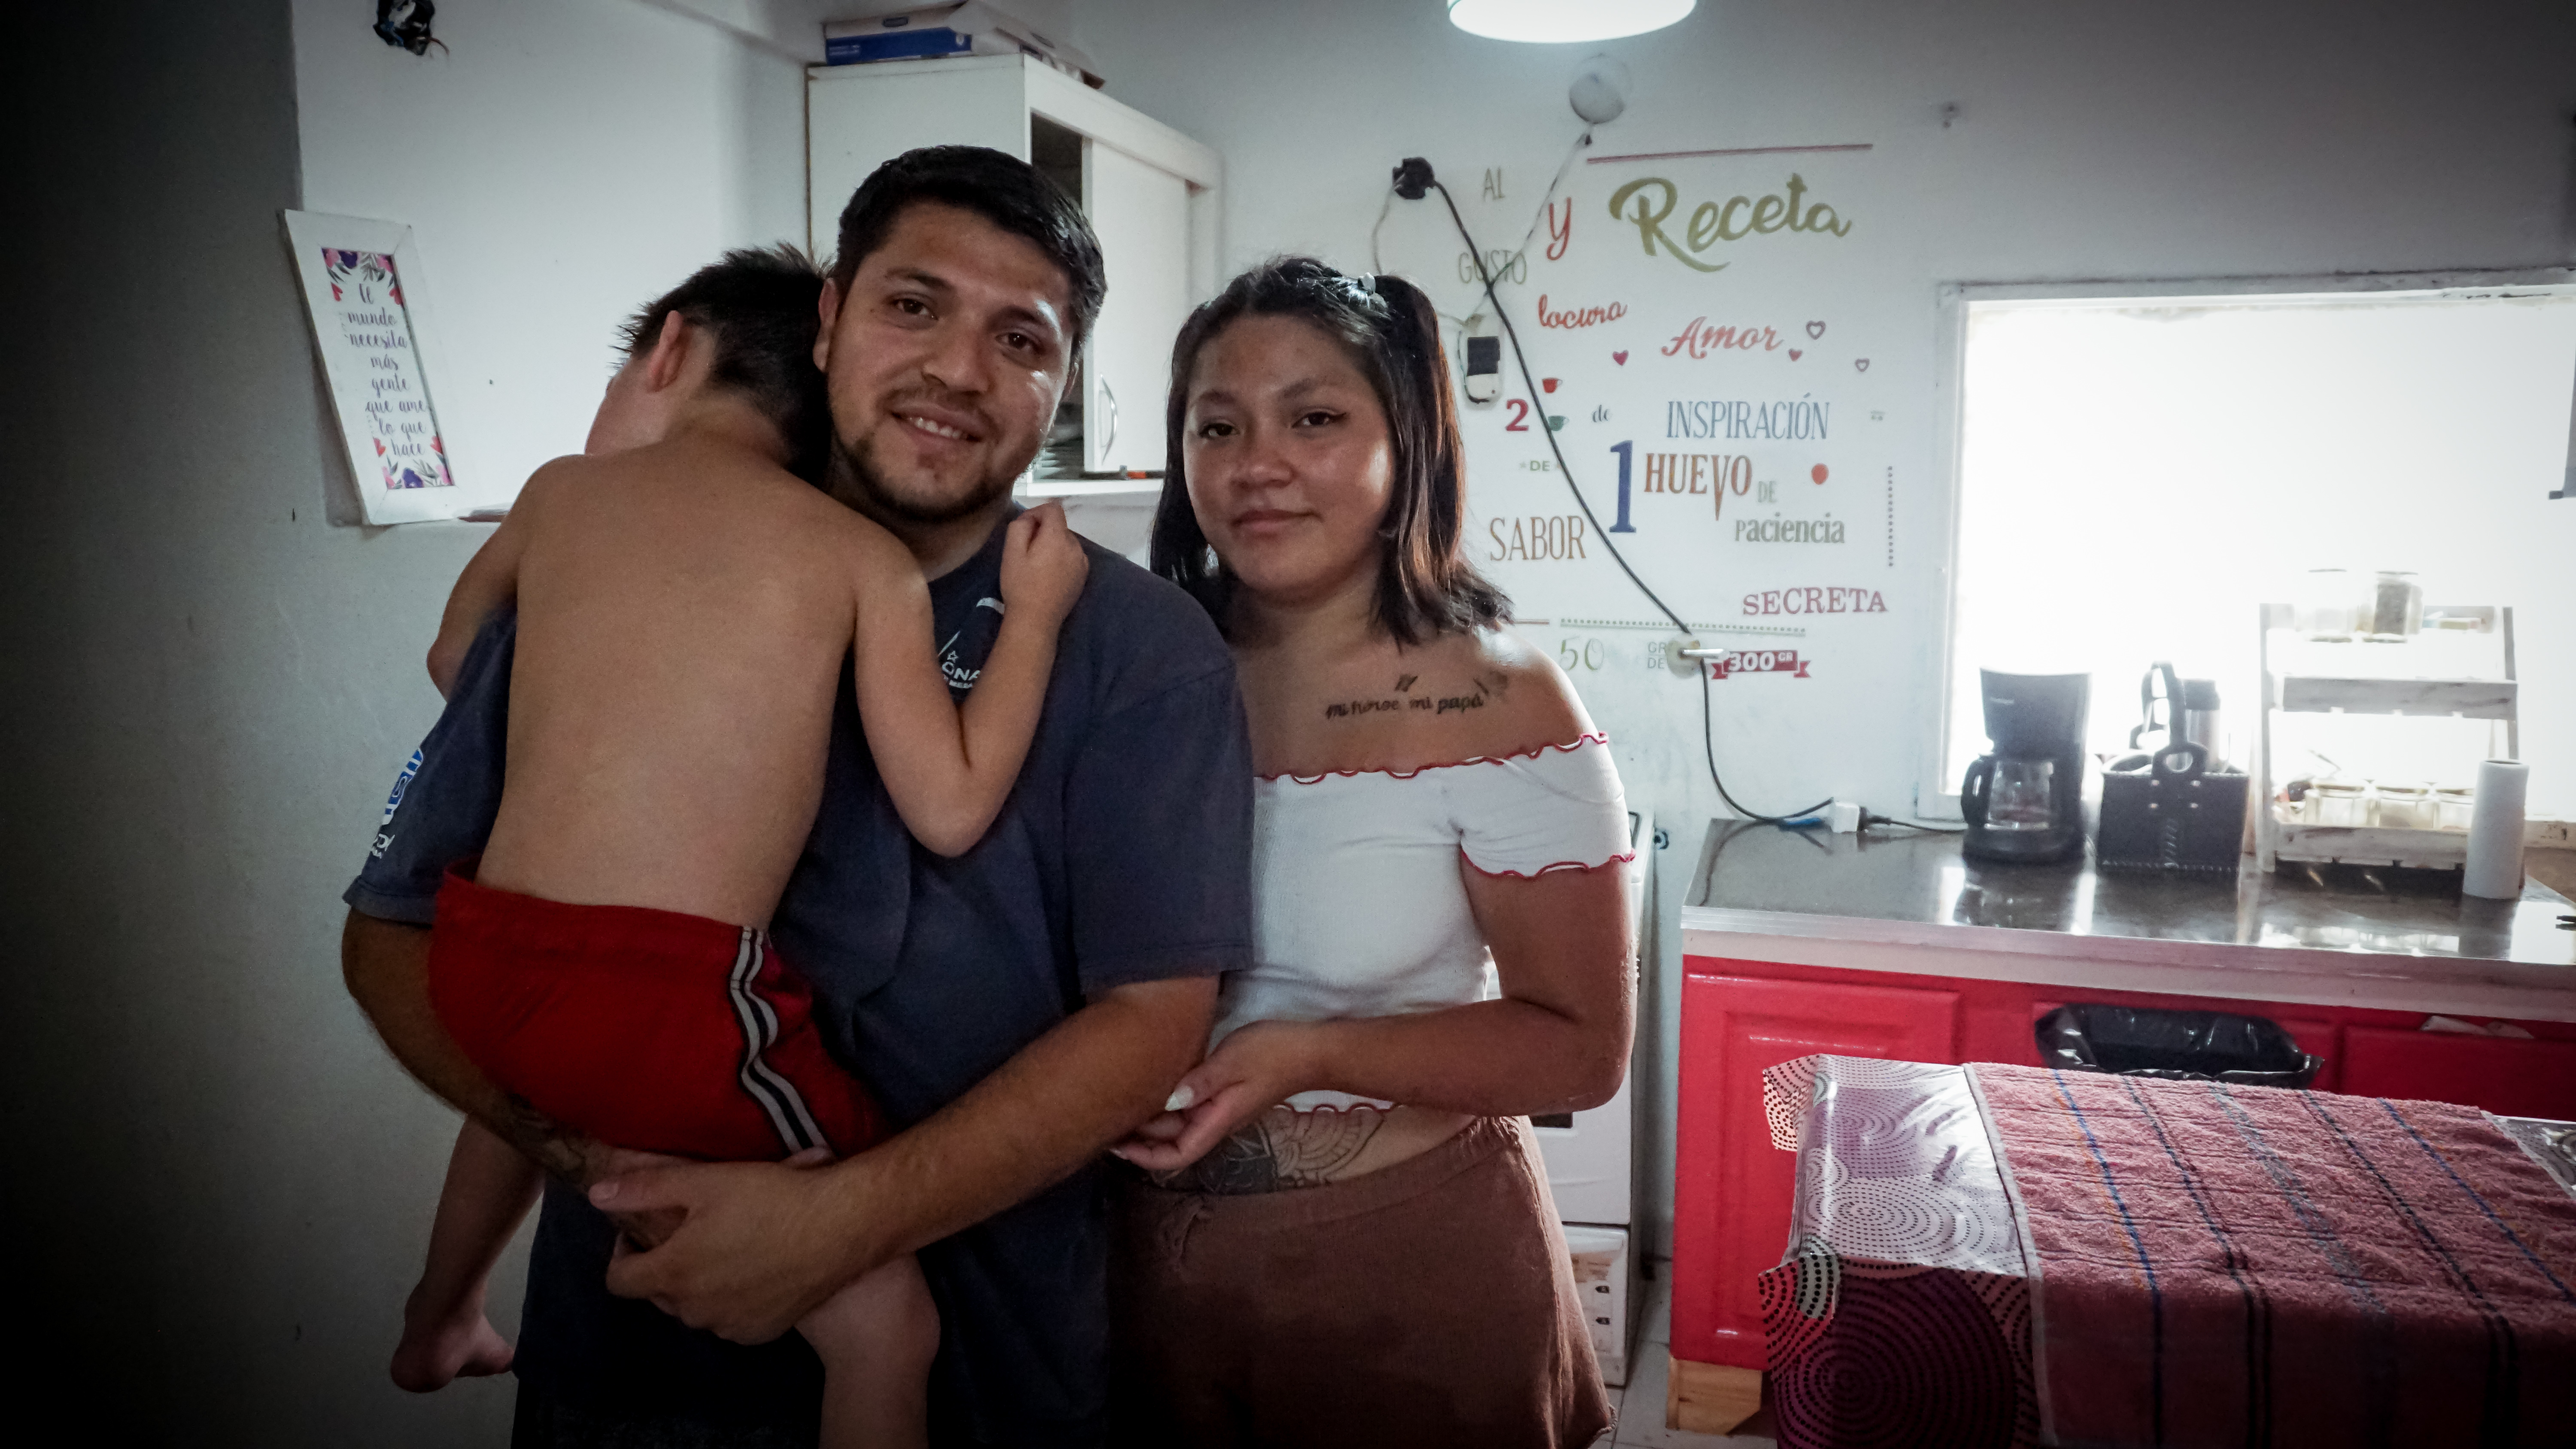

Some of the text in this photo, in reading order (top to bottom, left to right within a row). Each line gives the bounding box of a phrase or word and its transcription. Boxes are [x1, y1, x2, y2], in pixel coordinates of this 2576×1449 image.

[1609, 173, 1853, 273] Receta
[1458, 249, 1527, 285] GUSTO
[348, 306, 397, 326] mundo
[1538, 294, 1628, 329] locura
[349, 330, 407, 349] necesita
[1661, 316, 1783, 359] Amor
[371, 373, 410, 398] gente
[365, 400, 427, 421] que ame
[1505, 398, 1529, 431] 2
[1592, 404, 1611, 423] de
[1667, 393, 1830, 440] INSPIRACIÓN
[379, 418, 426, 442] lo que
[391, 438, 425, 458] hace
[1530, 460, 1550, 471] DE
[1609, 440, 1753, 533] 1 HUEVO
[1758, 480, 1777, 503] DE
[1489, 516, 1586, 561] SABOR
[1743, 587, 1888, 615] SECRETA
[1647, 658, 1666, 669] DE
[1728, 652, 1775, 671] 300
